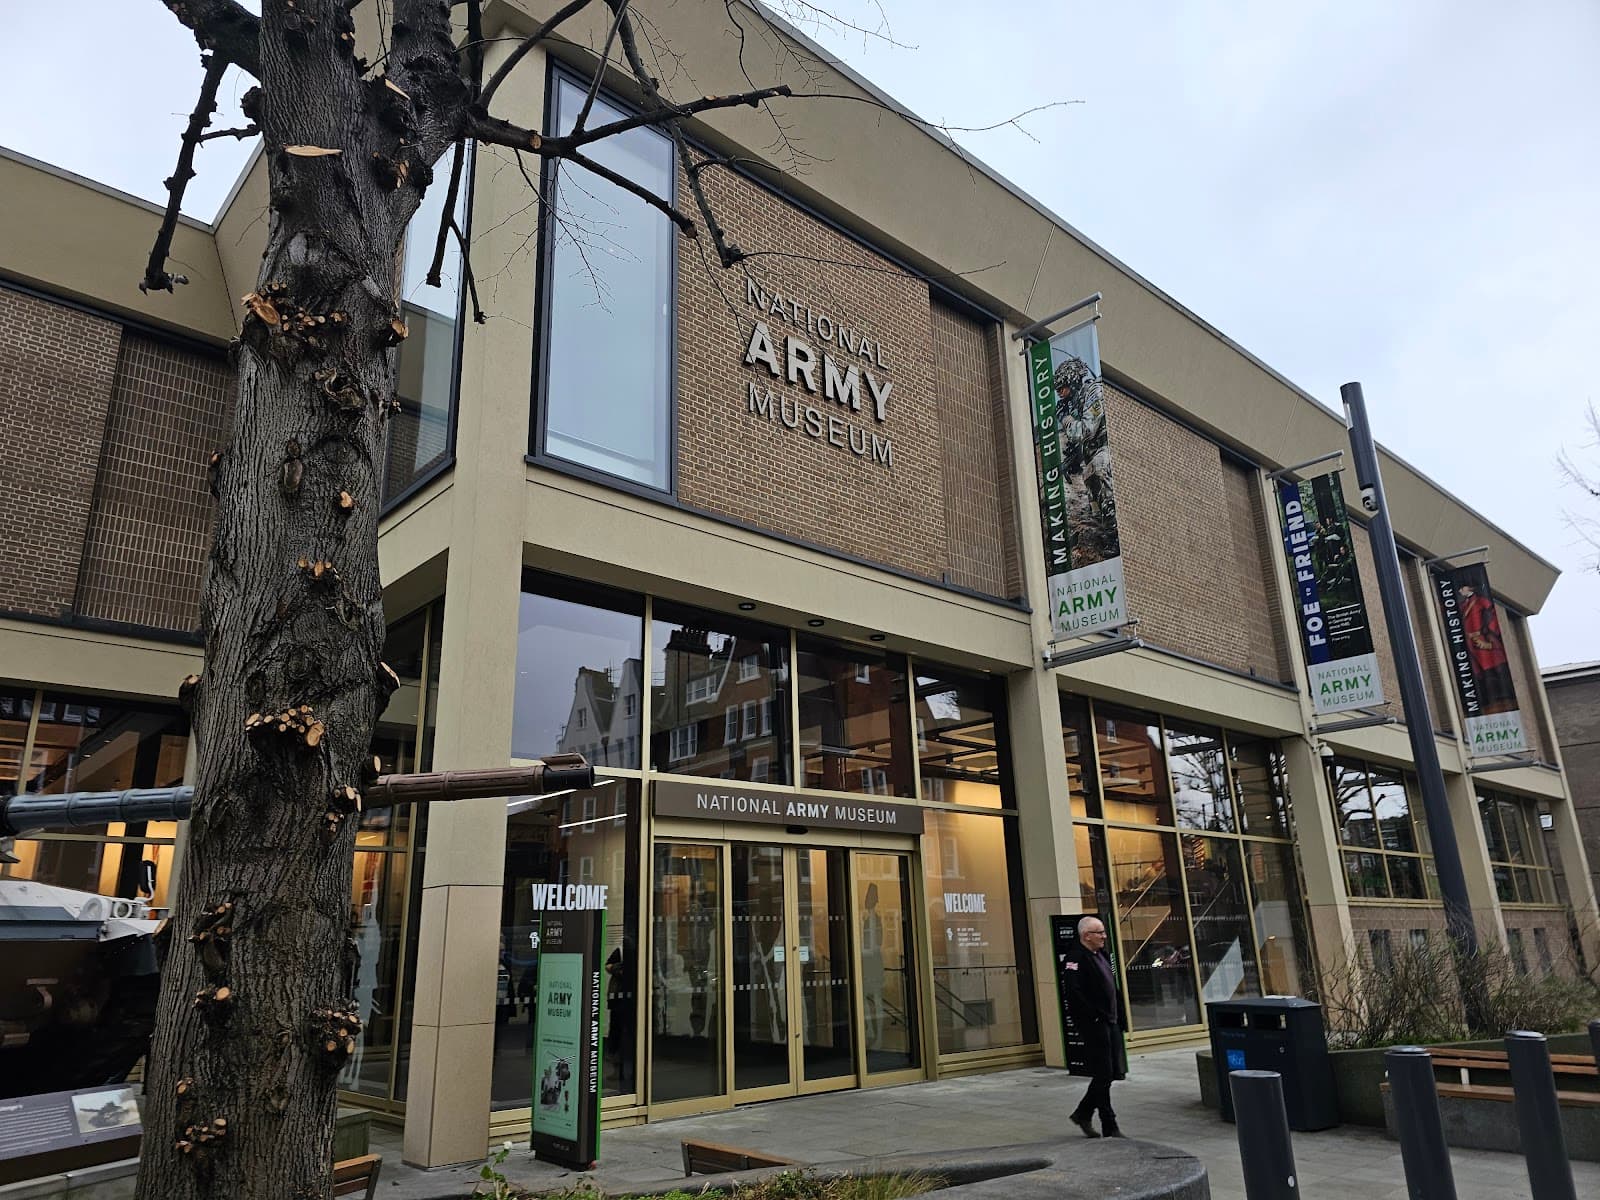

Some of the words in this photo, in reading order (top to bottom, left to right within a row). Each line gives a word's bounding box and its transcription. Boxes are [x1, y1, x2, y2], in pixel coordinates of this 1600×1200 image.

[746, 277, 889, 371] NATIONAL
[744, 320, 893, 422] ARMY
[1034, 356, 1057, 457] HISTORY
[748, 381, 893, 467] MUSEUM
[1046, 467, 1068, 565] MAKING
[1285, 500, 1315, 583] FRIEND
[1056, 573, 1116, 597] NATIONAL
[1058, 586, 1117, 618] ARMY
[1439, 580, 1464, 644] HISTORY
[1060, 608, 1120, 633] MUSEUM
[1303, 601, 1326, 647] FOE
[1317, 664, 1370, 680] NATIONAL
[1320, 674, 1372, 695] ARMY
[1455, 650, 1479, 712] MAKING
[1322, 690, 1375, 707] MUSEUM
[1473, 720, 1517, 732] NATIONAL
[1475, 728, 1519, 744] ARMY
[1477, 741, 1521, 753] MUSEUM
[696, 793, 781, 815] NATIONAL
[786, 802, 829, 819] ARMY
[835, 806, 897, 825] MUSEUM
[531, 883, 609, 911] WELCOME
[944, 892, 987, 913] WELCOME
[546, 928, 563, 937] ARMY
[547, 991, 573, 1006] ARMY
[591, 971, 600, 1018] NATIONAL
[547, 1007, 572, 1018] MUSEUM
[590, 1020, 598, 1047] ARMY
[589, 1050, 598, 1093] MUSEUM
